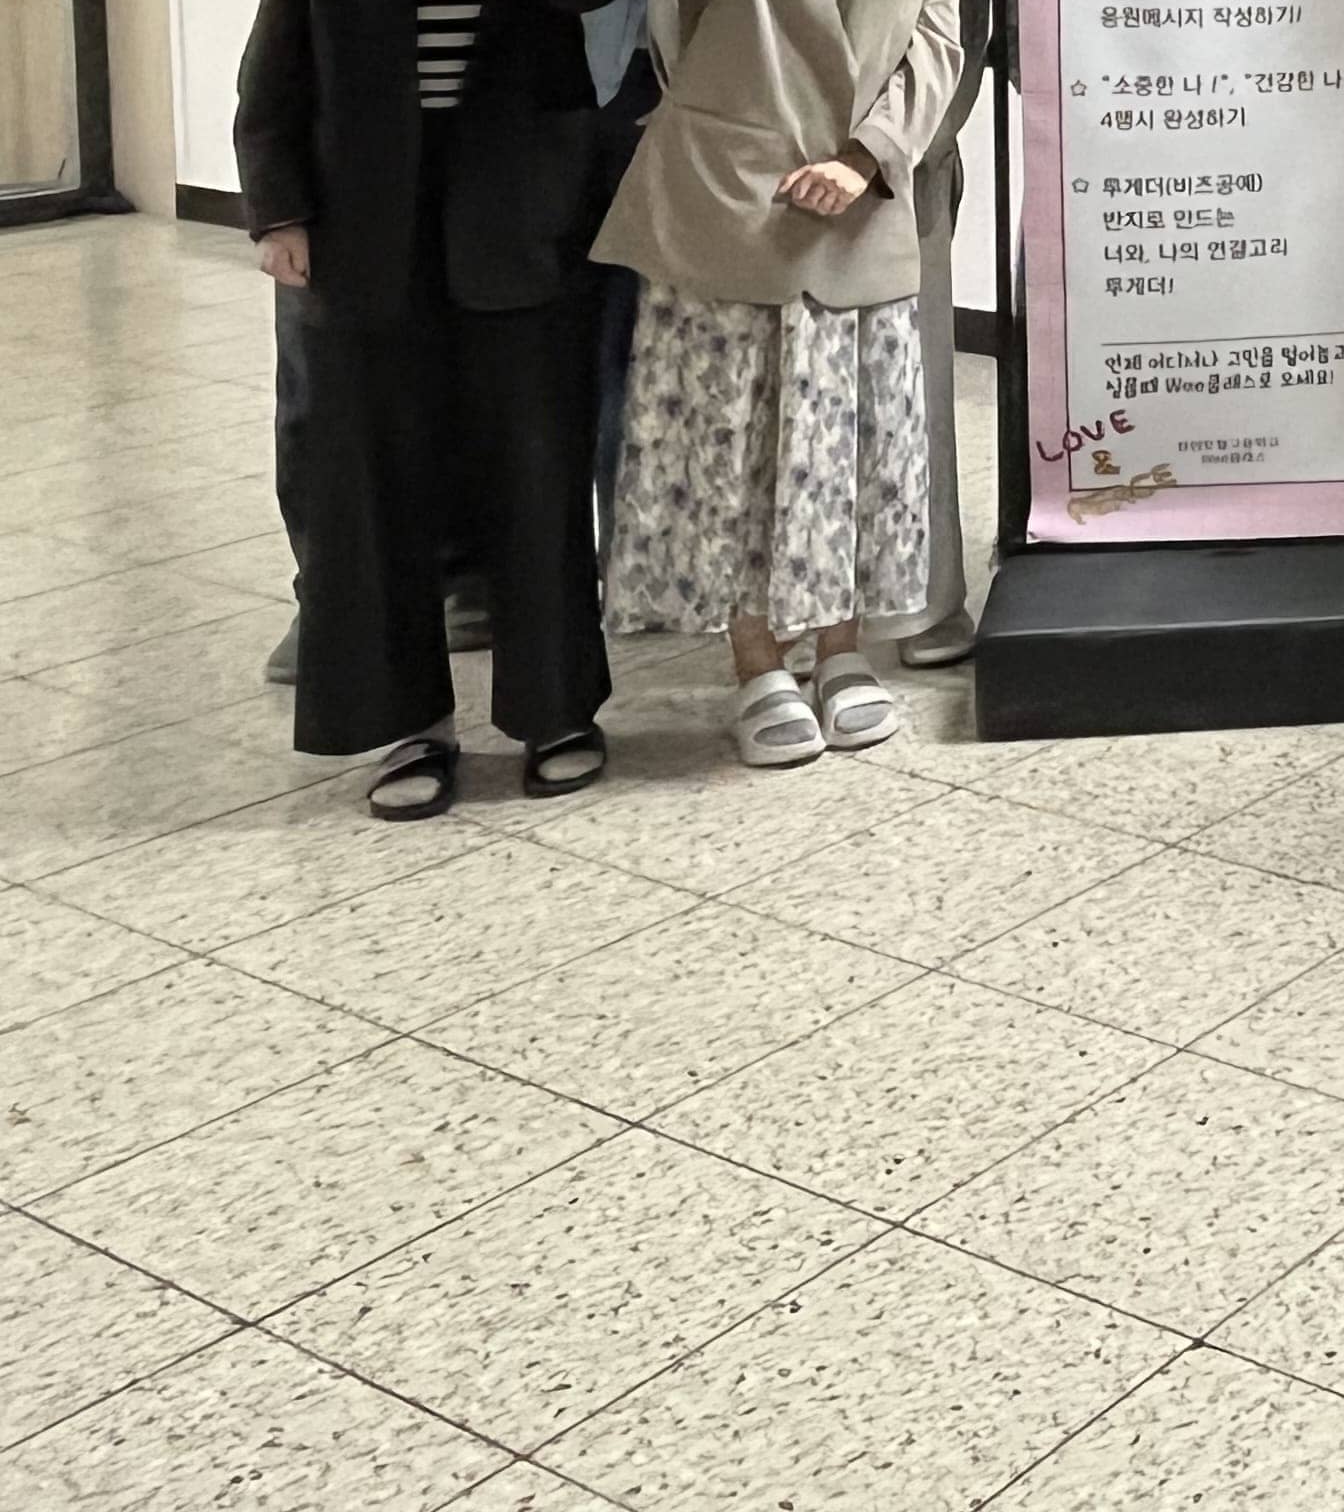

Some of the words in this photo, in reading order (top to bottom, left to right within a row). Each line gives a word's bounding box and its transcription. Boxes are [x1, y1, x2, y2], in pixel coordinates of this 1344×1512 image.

[1100, 6, 1204, 29] 응원메시지
[1213, 5, 1303, 28] 작성하기!
[1100, 108, 1155, 131] 4행시
[1163, 106, 1247, 131] 완성하기
[1103, 209, 1166, 232] 반지로
[1173, 207, 1235, 230] 만드는
[1104, 242, 1150, 265] 너와,
[1158, 240, 1199, 262] 나의
[1207, 237, 1288, 262] 연결고리
[1036, 409, 1136, 462] LOVE
